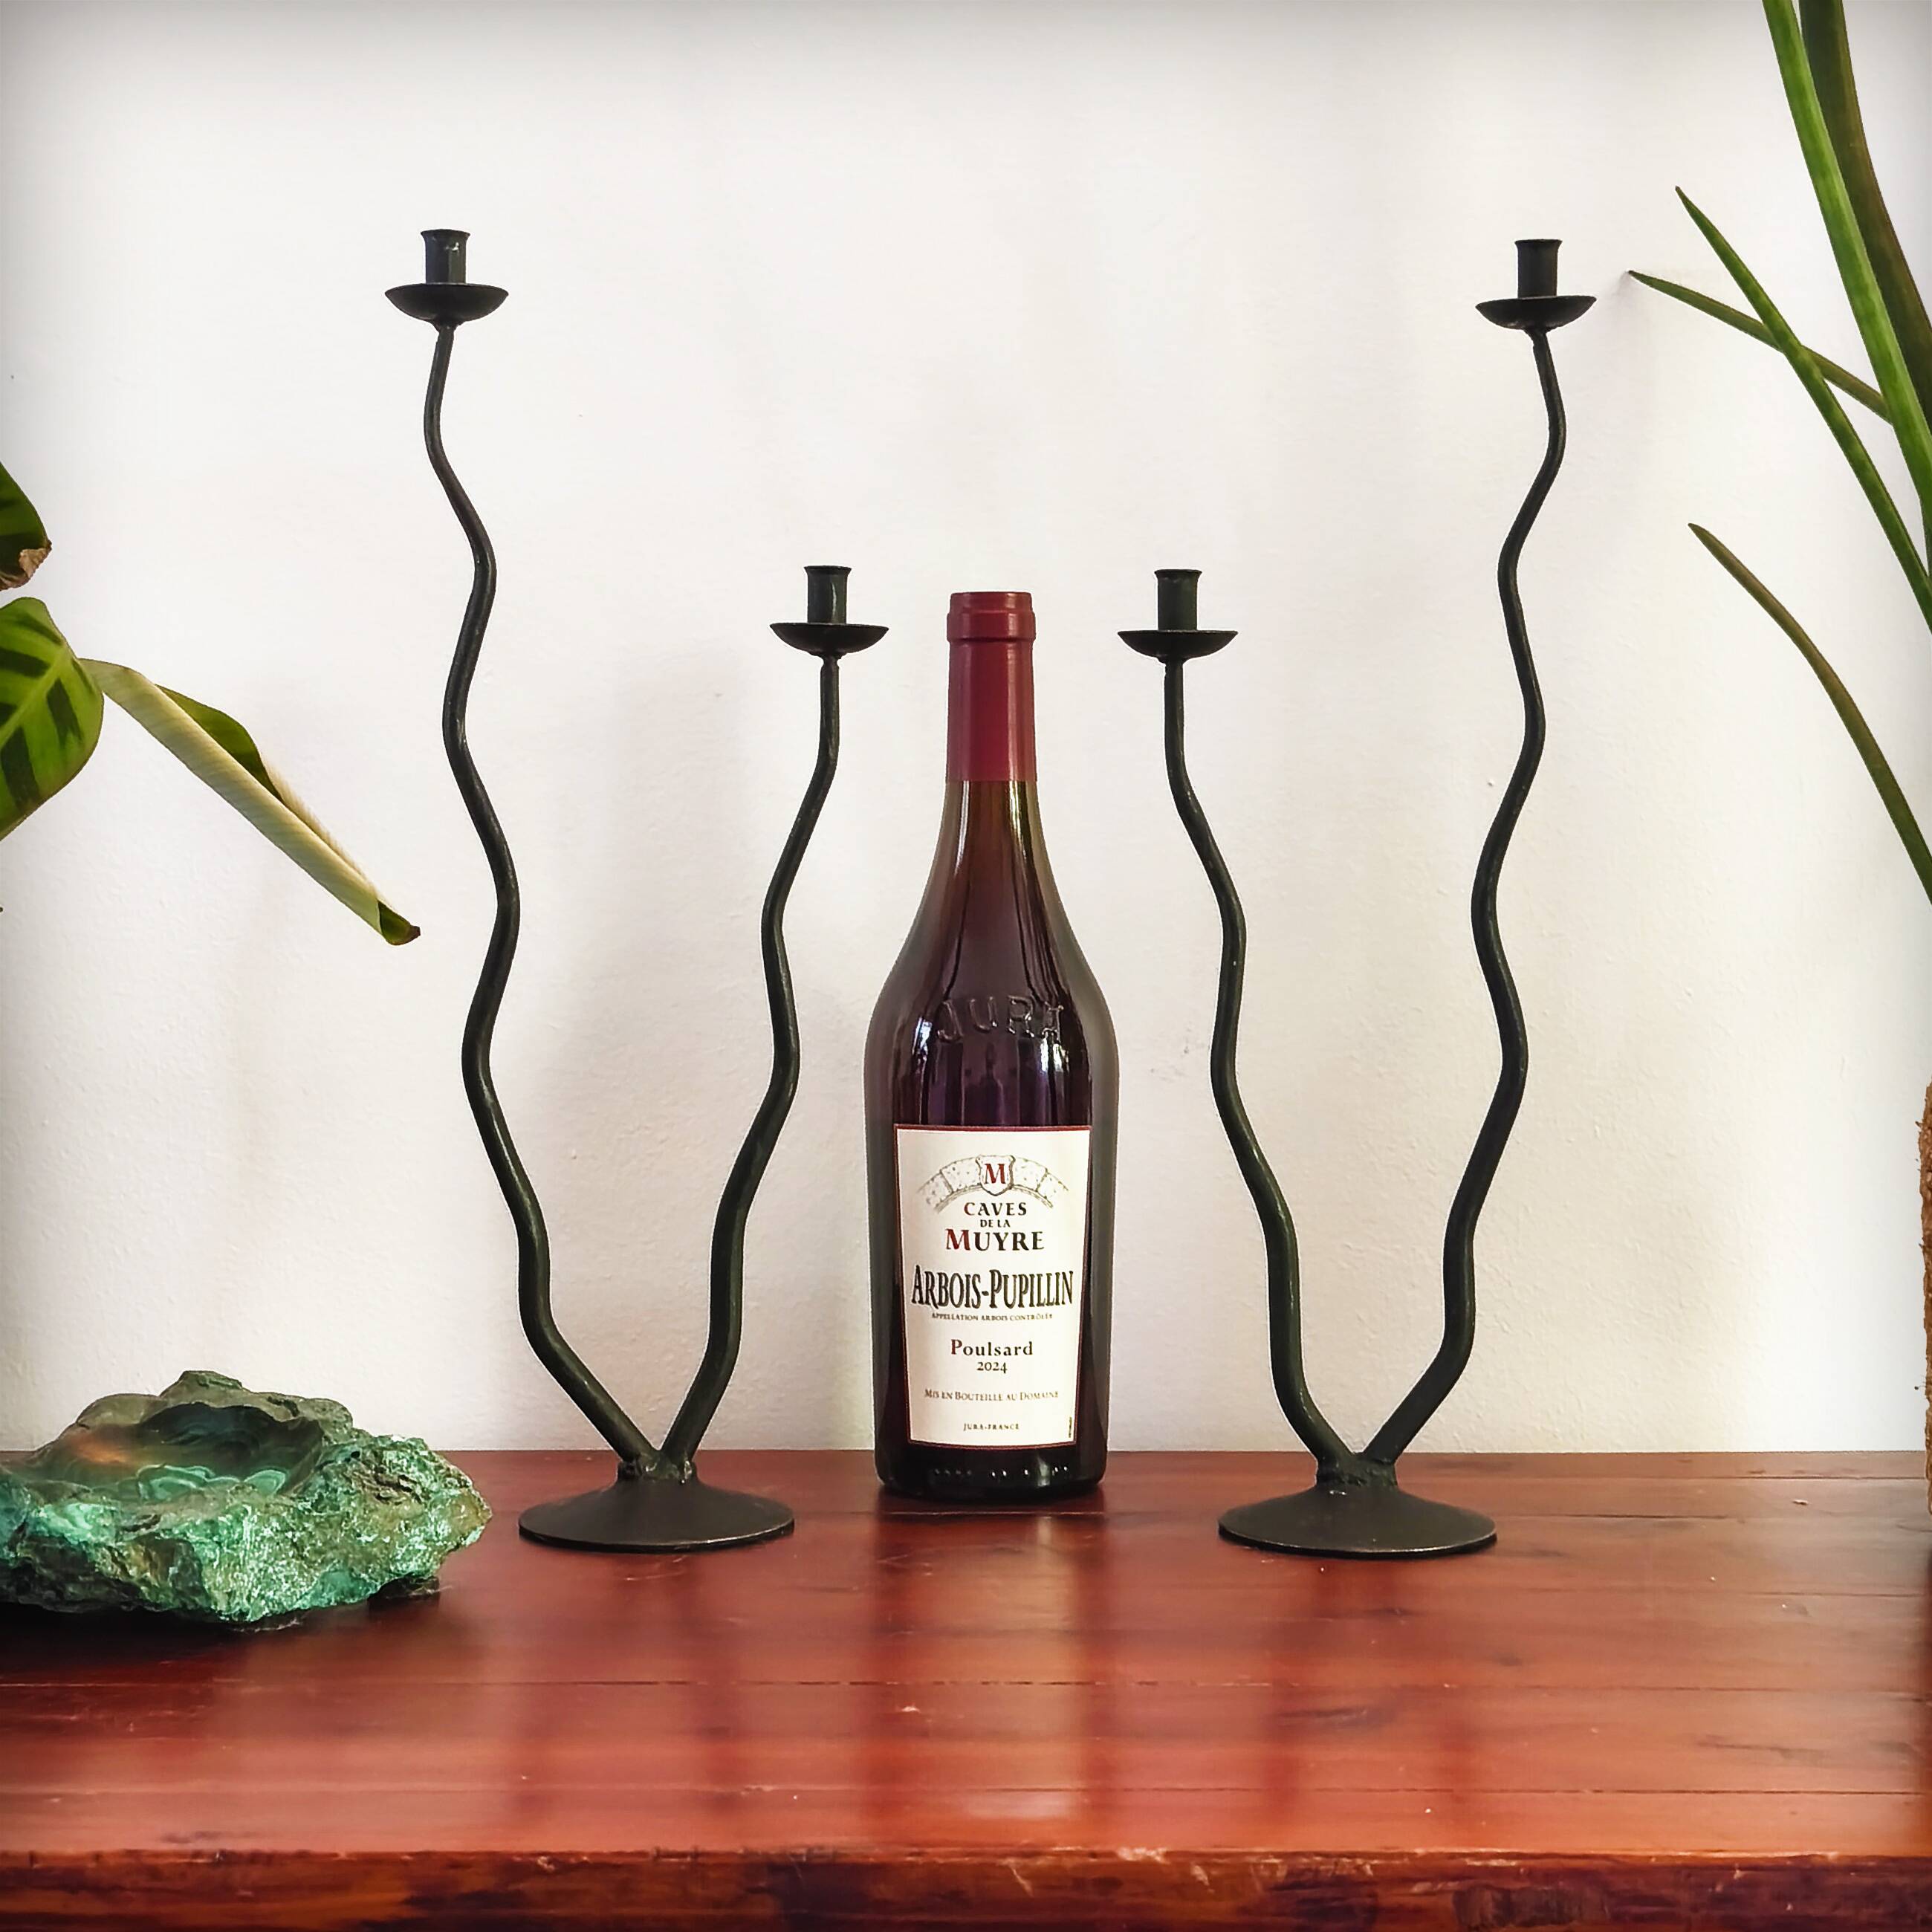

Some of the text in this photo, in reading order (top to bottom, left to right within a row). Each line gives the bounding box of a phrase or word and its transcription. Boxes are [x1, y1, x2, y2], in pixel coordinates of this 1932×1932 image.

[984, 1163, 1006, 1184] M
[964, 1202, 1027, 1216] CAVES
[980, 1219, 1011, 1228] DE LA
[945, 1228, 1045, 1251] MUYRE
[911, 1264, 1074, 1309] ARBOIS-PUPILLIN
[932, 1312, 978, 1321] APPELLATION
[950, 1339, 1033, 1356] Poulsard
[976, 1361, 1008, 1374] 2024
[941, 1390, 953, 1400] EN
[955, 1390, 1002, 1401] BOUTEILLE
[1007, 1393, 1017, 1401] AU
[963, 1422, 1020, 1432] JURA-FRANCE
